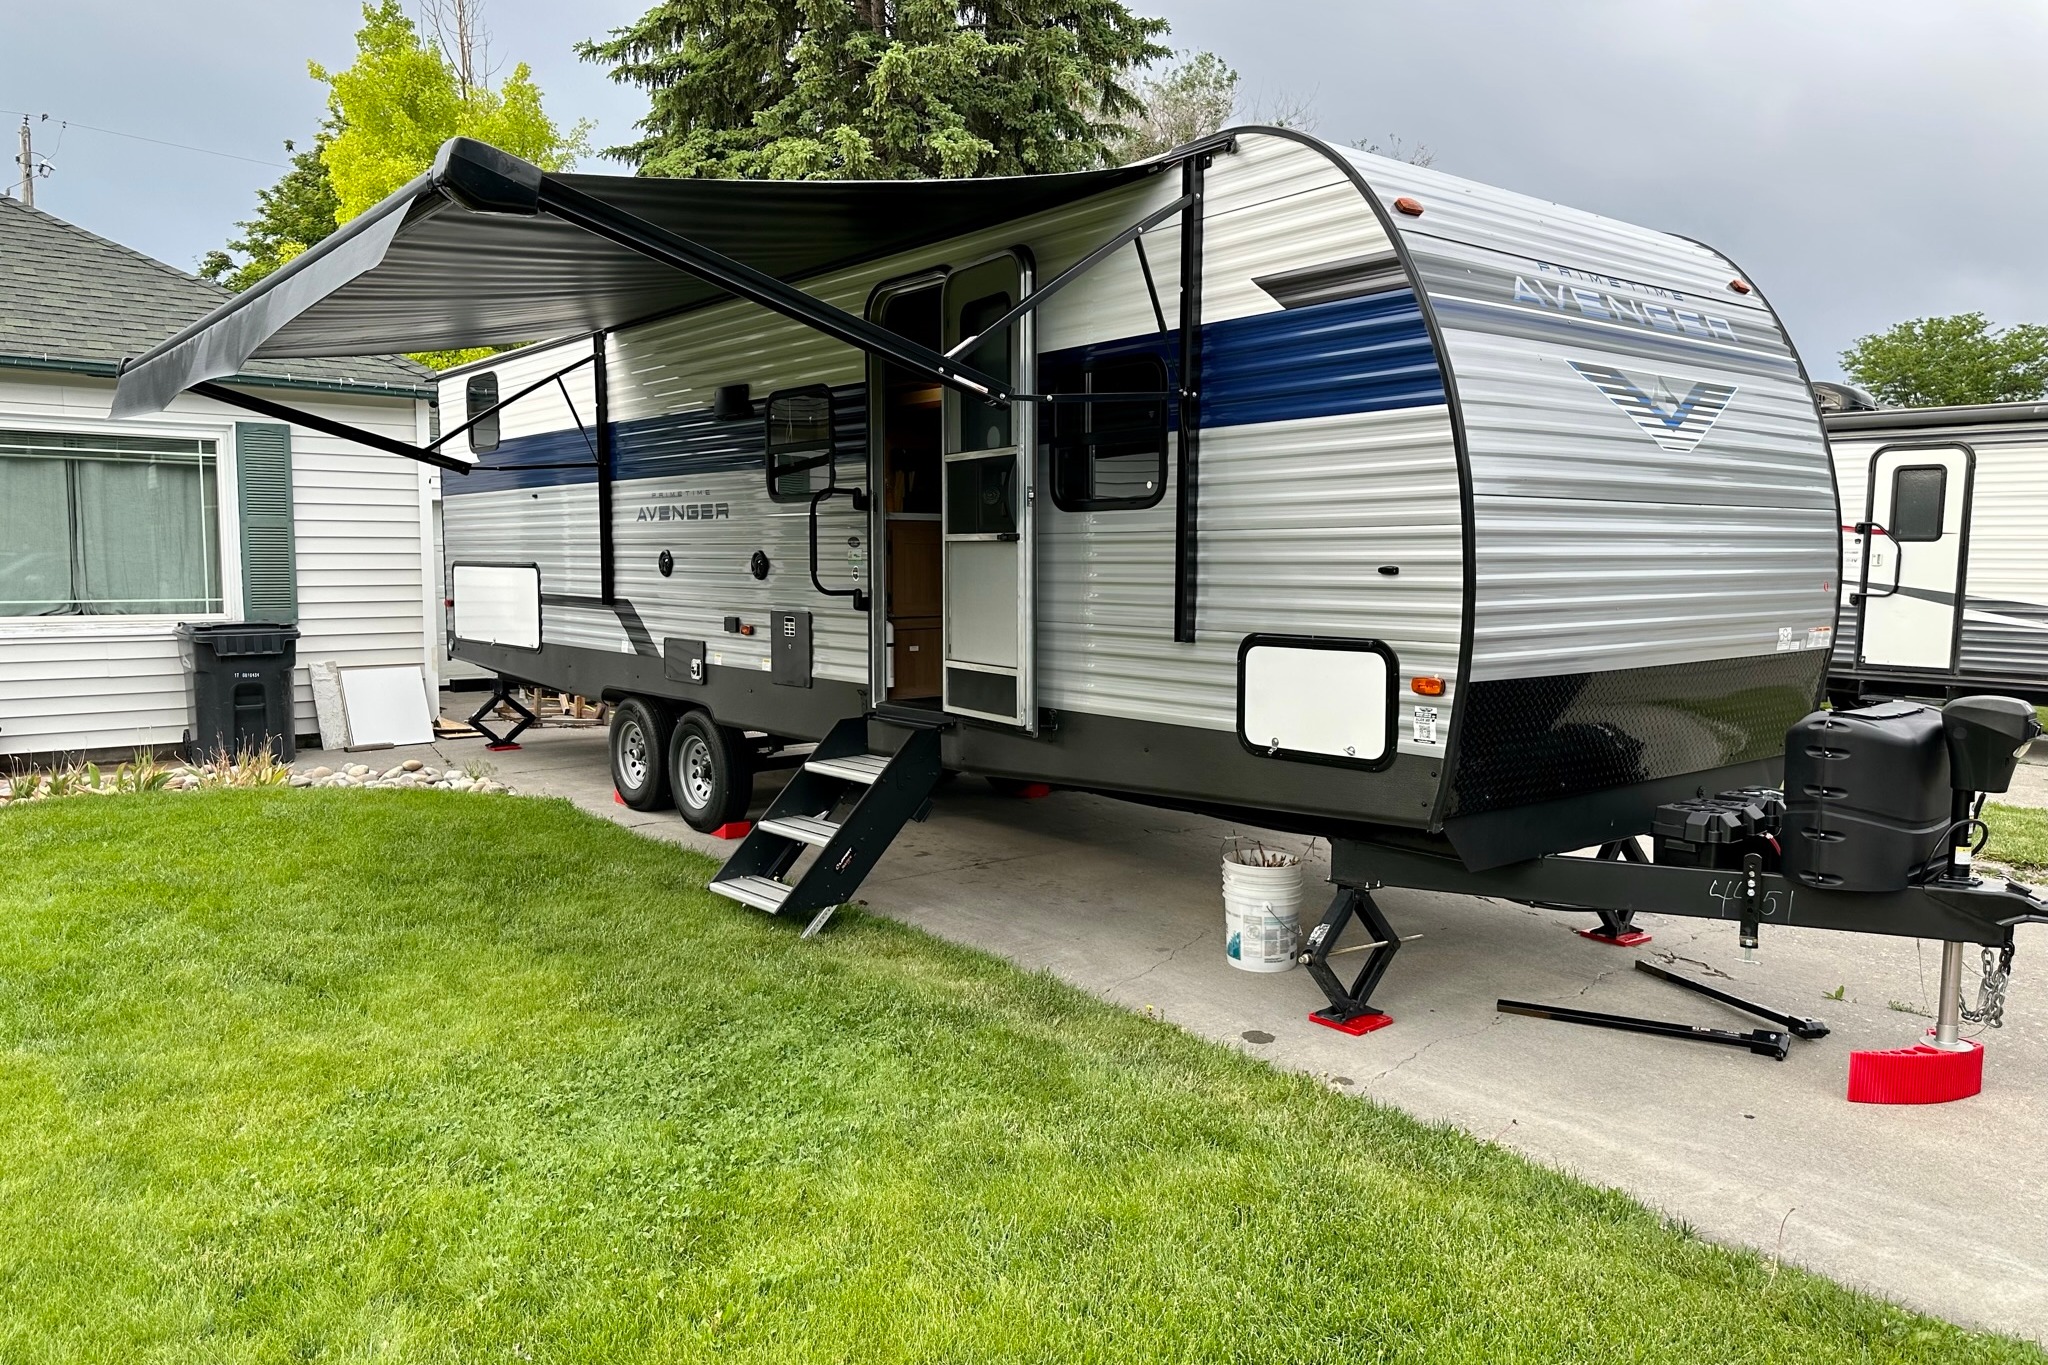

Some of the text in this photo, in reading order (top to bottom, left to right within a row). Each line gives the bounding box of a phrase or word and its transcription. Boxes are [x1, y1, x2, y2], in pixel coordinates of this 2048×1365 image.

[1537, 262, 1684, 301] PRIMETIME
[1513, 275, 1739, 342] AVENGER
[651, 489, 711, 499] PRIMETIME
[636, 502, 729, 522] AVENGER
